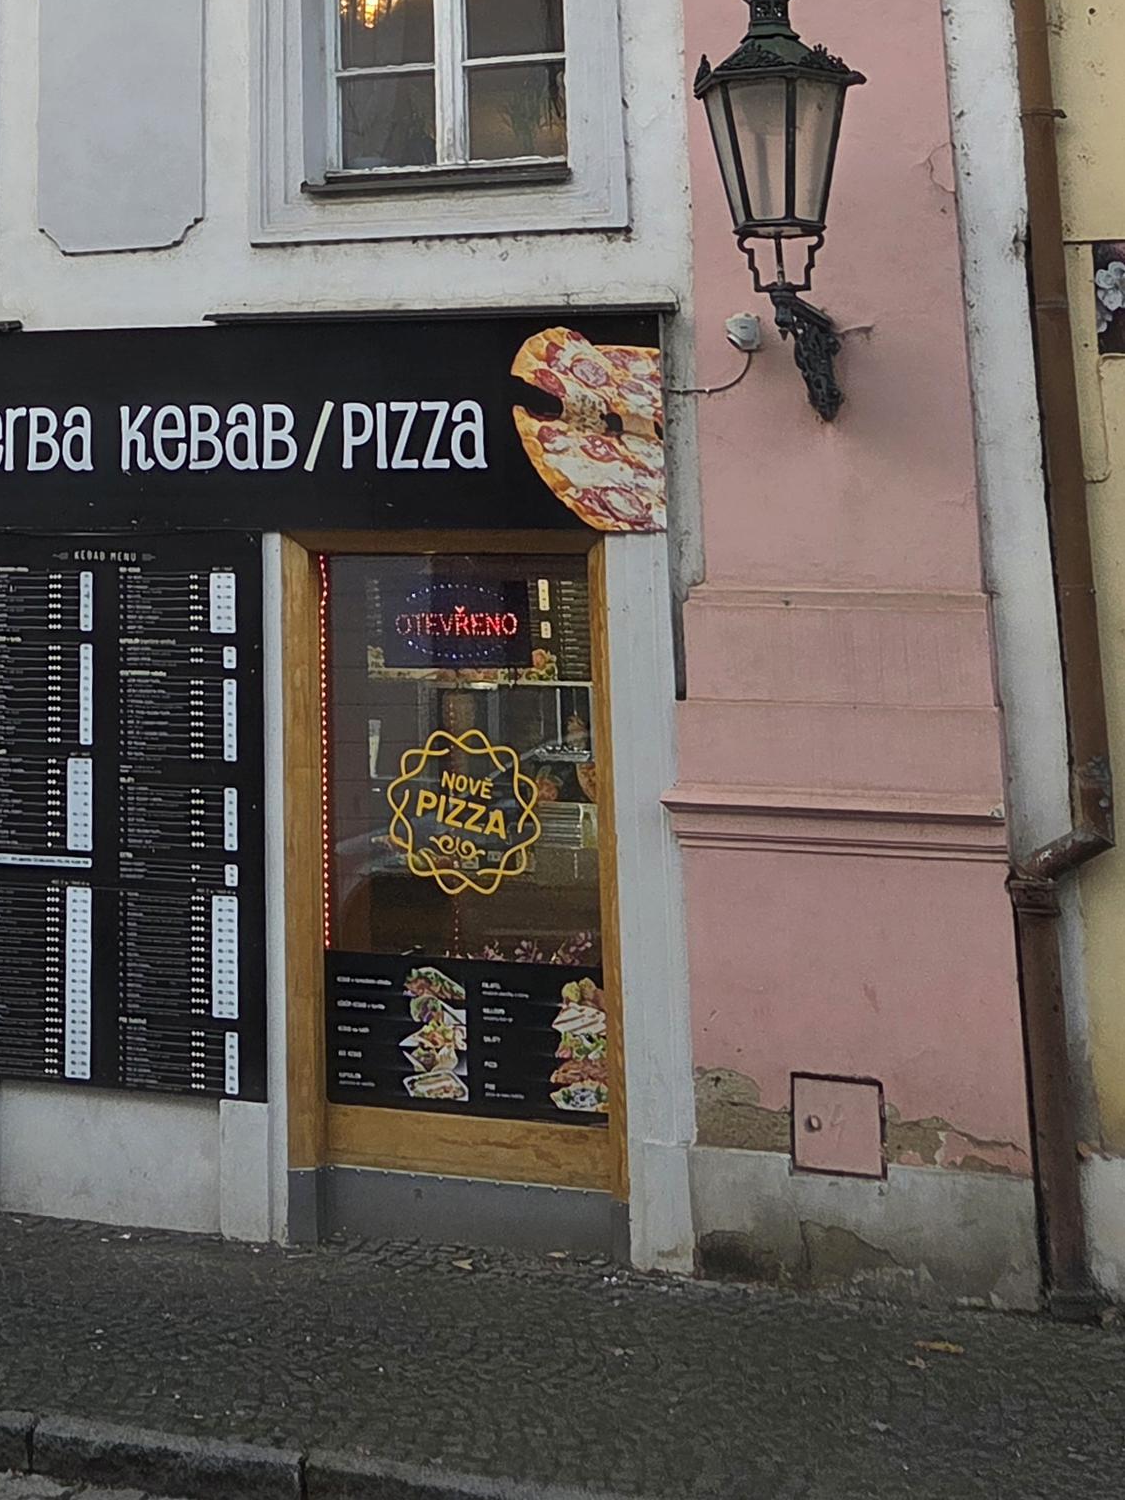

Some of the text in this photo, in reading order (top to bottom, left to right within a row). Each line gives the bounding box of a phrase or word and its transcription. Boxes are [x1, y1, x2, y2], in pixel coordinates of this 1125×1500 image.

[110, 551, 137, 563] MENU
[394, 605, 519, 636] OTEVŘENO
[415, 789, 507, 840] PIZZA
